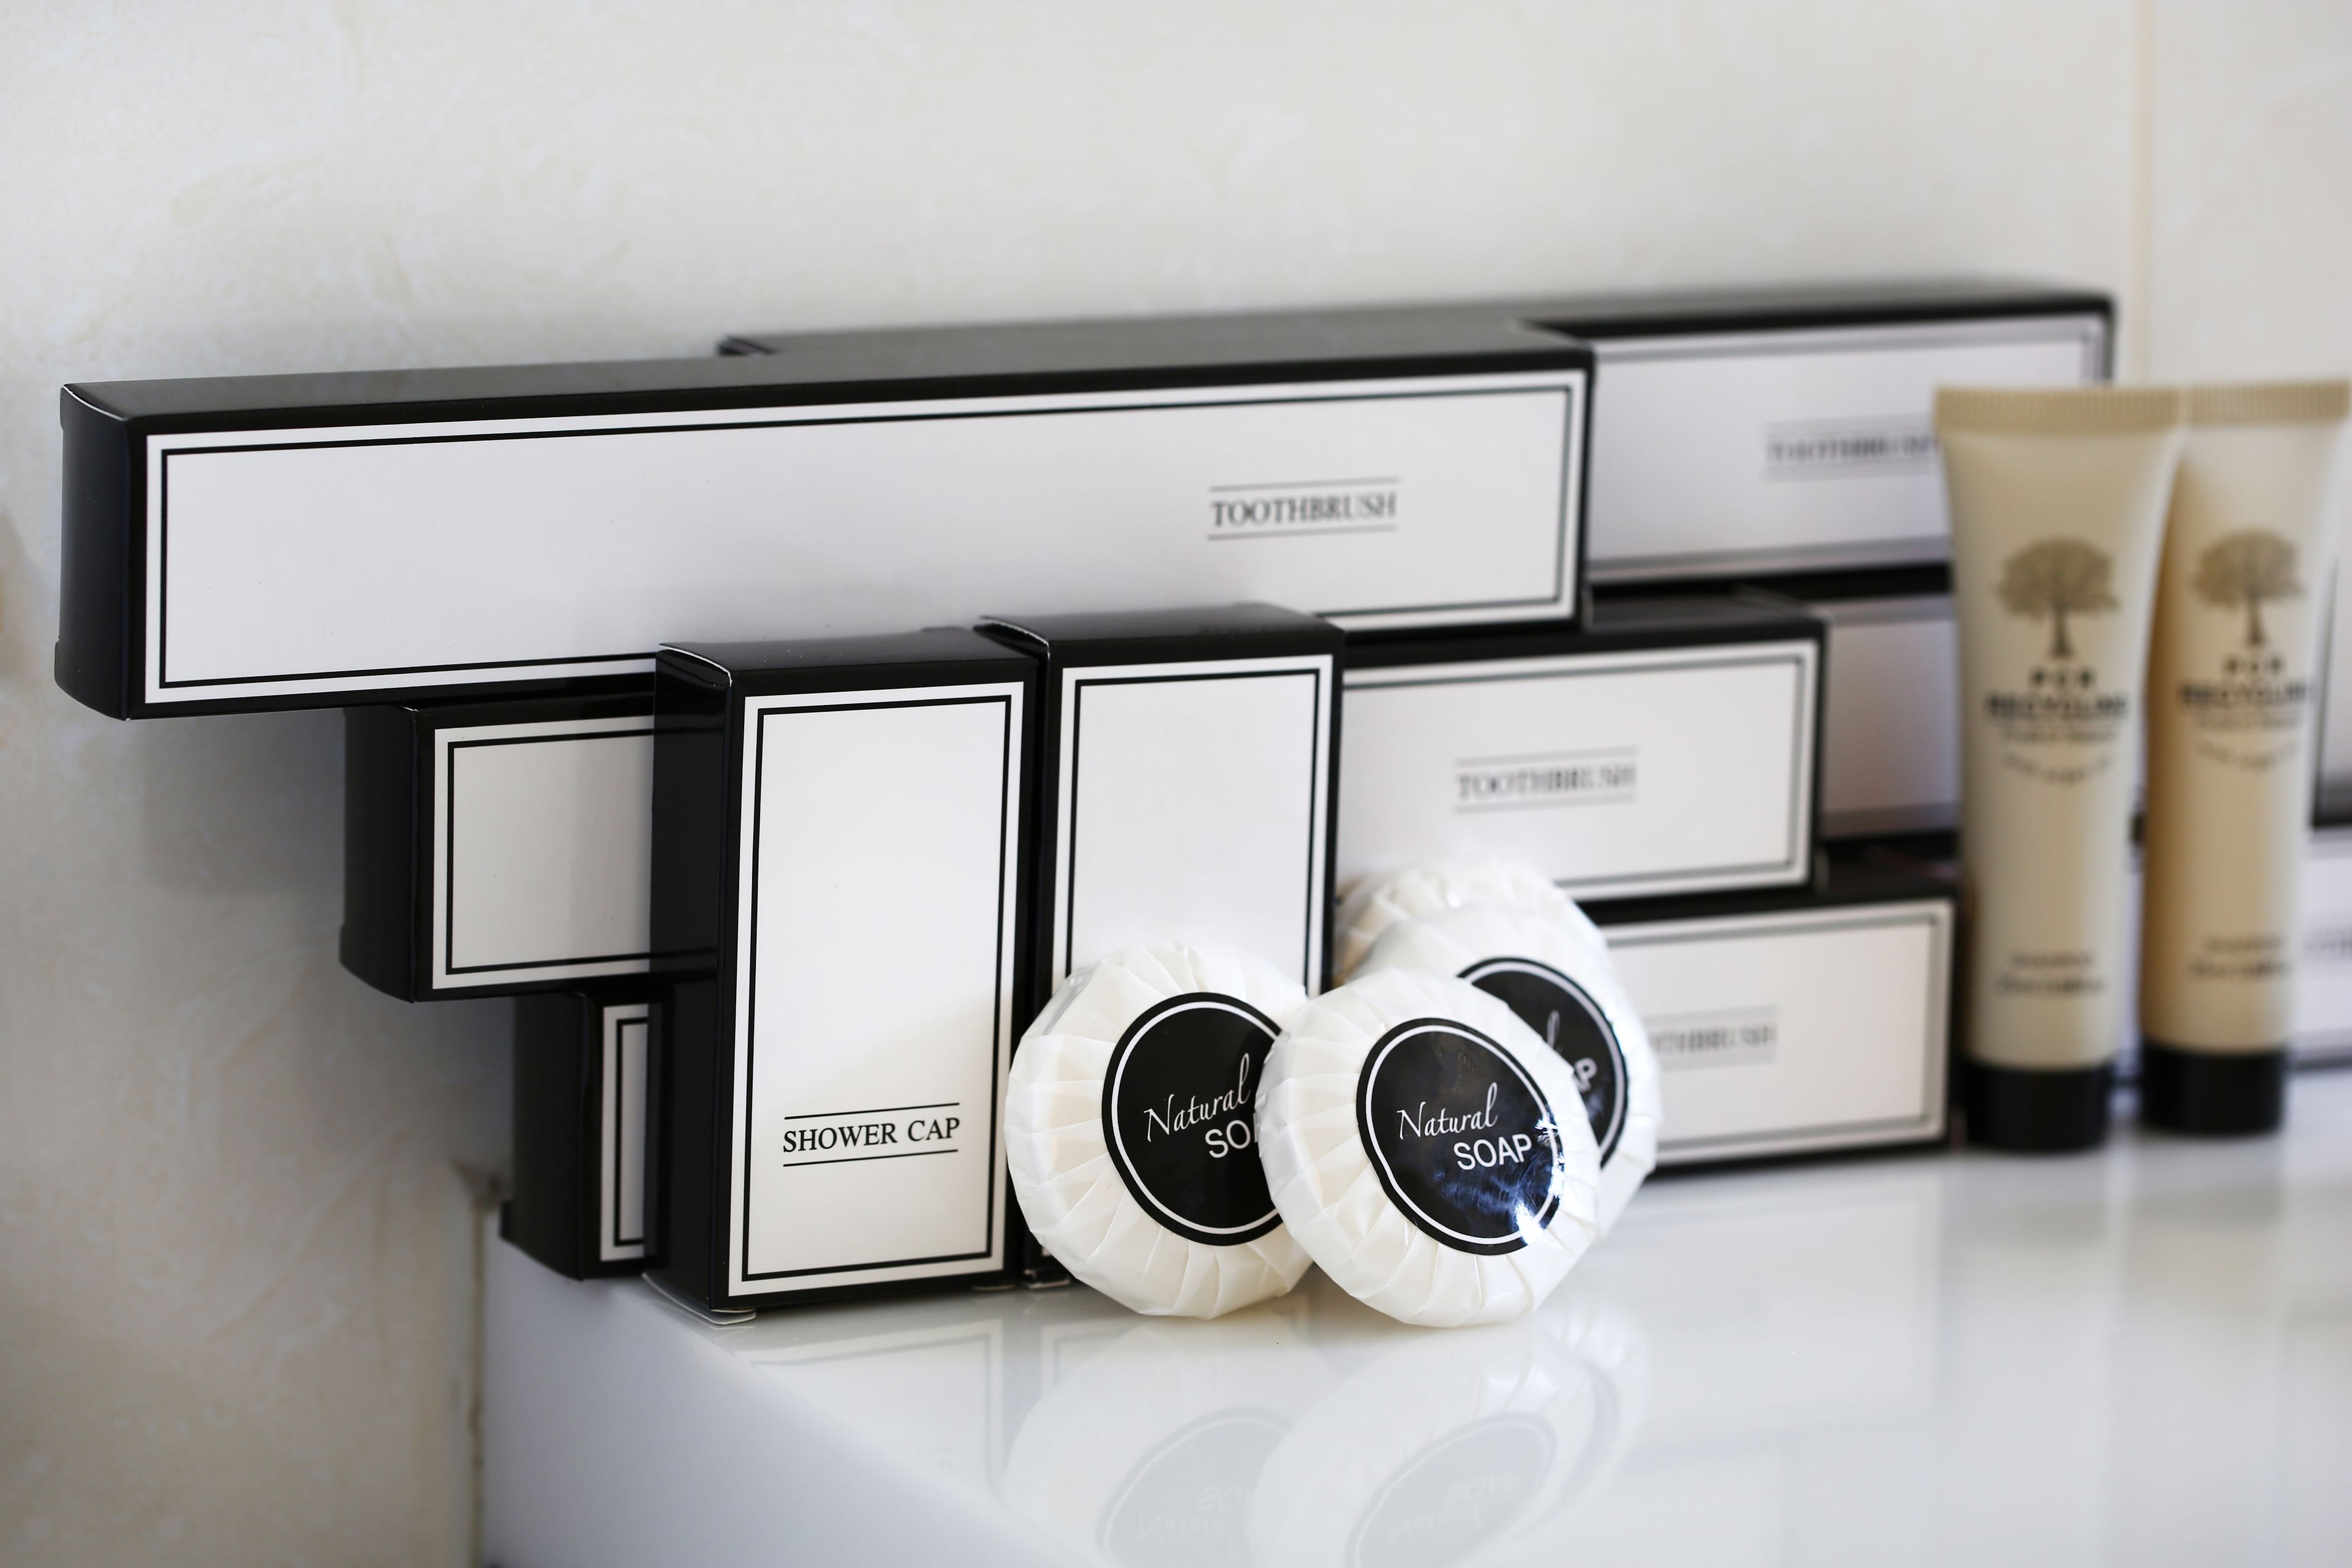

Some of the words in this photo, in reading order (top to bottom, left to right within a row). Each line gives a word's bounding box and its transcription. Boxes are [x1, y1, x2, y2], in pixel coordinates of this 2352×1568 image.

[1209, 491, 1397, 527] TOOTHBRUSH
[1456, 763, 1637, 801] TOOTHBRUSH
[1144, 1053, 1251, 1142] Natural
[1396, 1082, 1498, 1140] Natural
[783, 1123, 897, 1153] SHOWER
[908, 1117, 960, 1142] CAP
[1205, 1120, 1258, 1158] SO
[1453, 1134, 1532, 1170] SOAP
